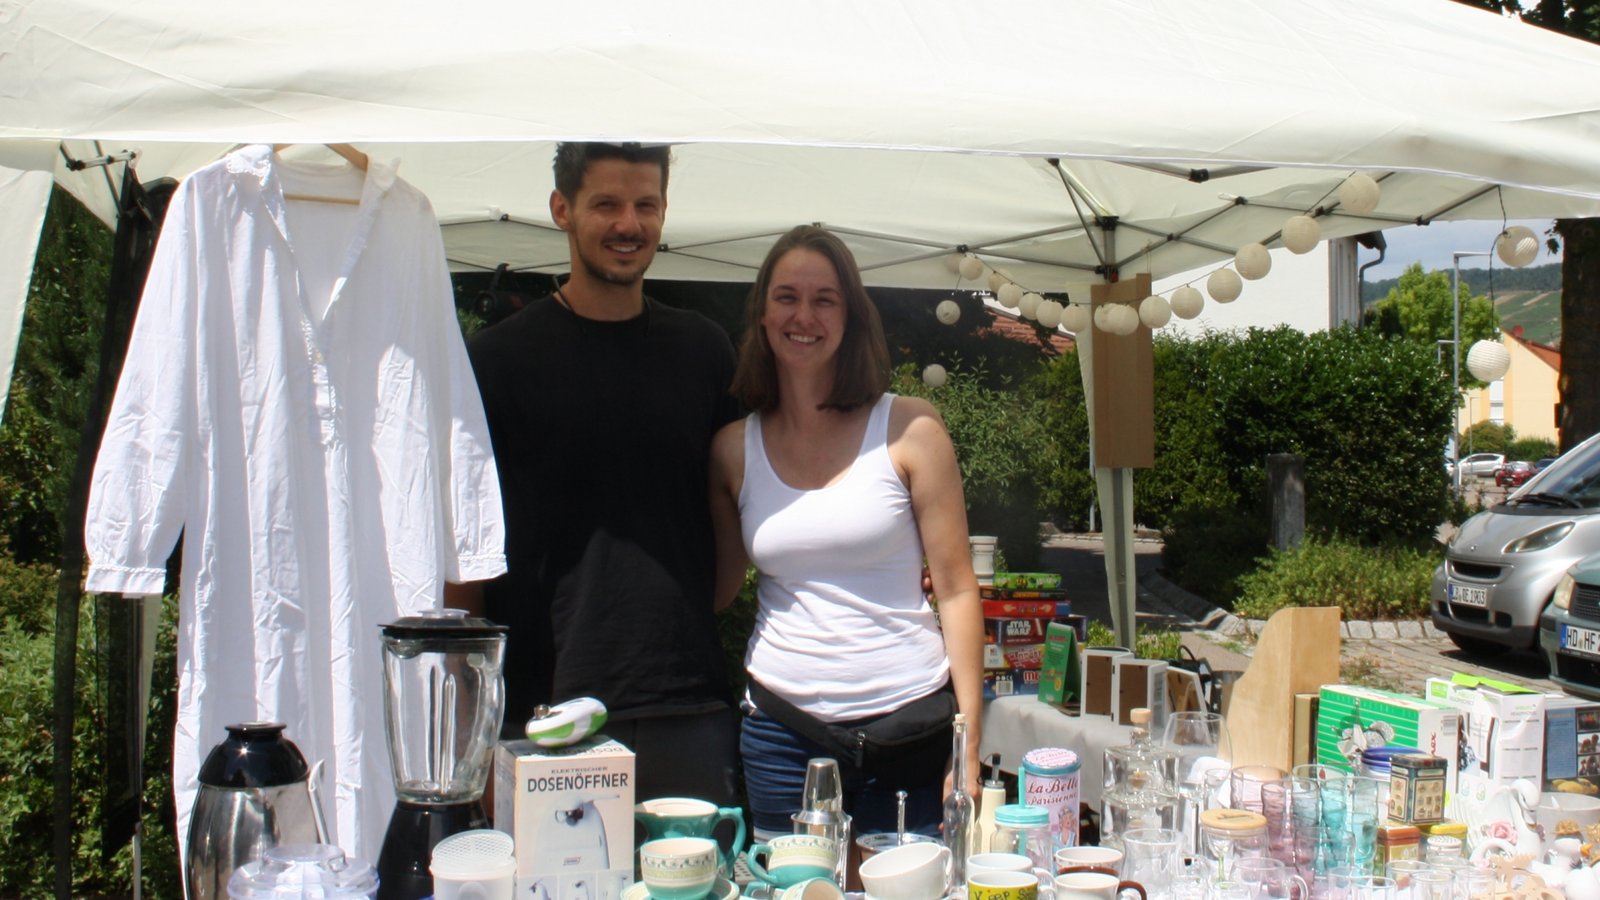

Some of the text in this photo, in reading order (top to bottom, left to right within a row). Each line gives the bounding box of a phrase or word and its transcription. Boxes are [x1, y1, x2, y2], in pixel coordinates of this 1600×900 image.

[1007, 620, 1031, 629] STAR
[1007, 628, 1031, 636] WARS
[1566, 627, 1578, 648] HD
[551, 766, 608, 774] ELEKTRISCHER
[527, 772, 629, 793] DOSENÖFFNER
[1027, 781, 1044, 794] La
